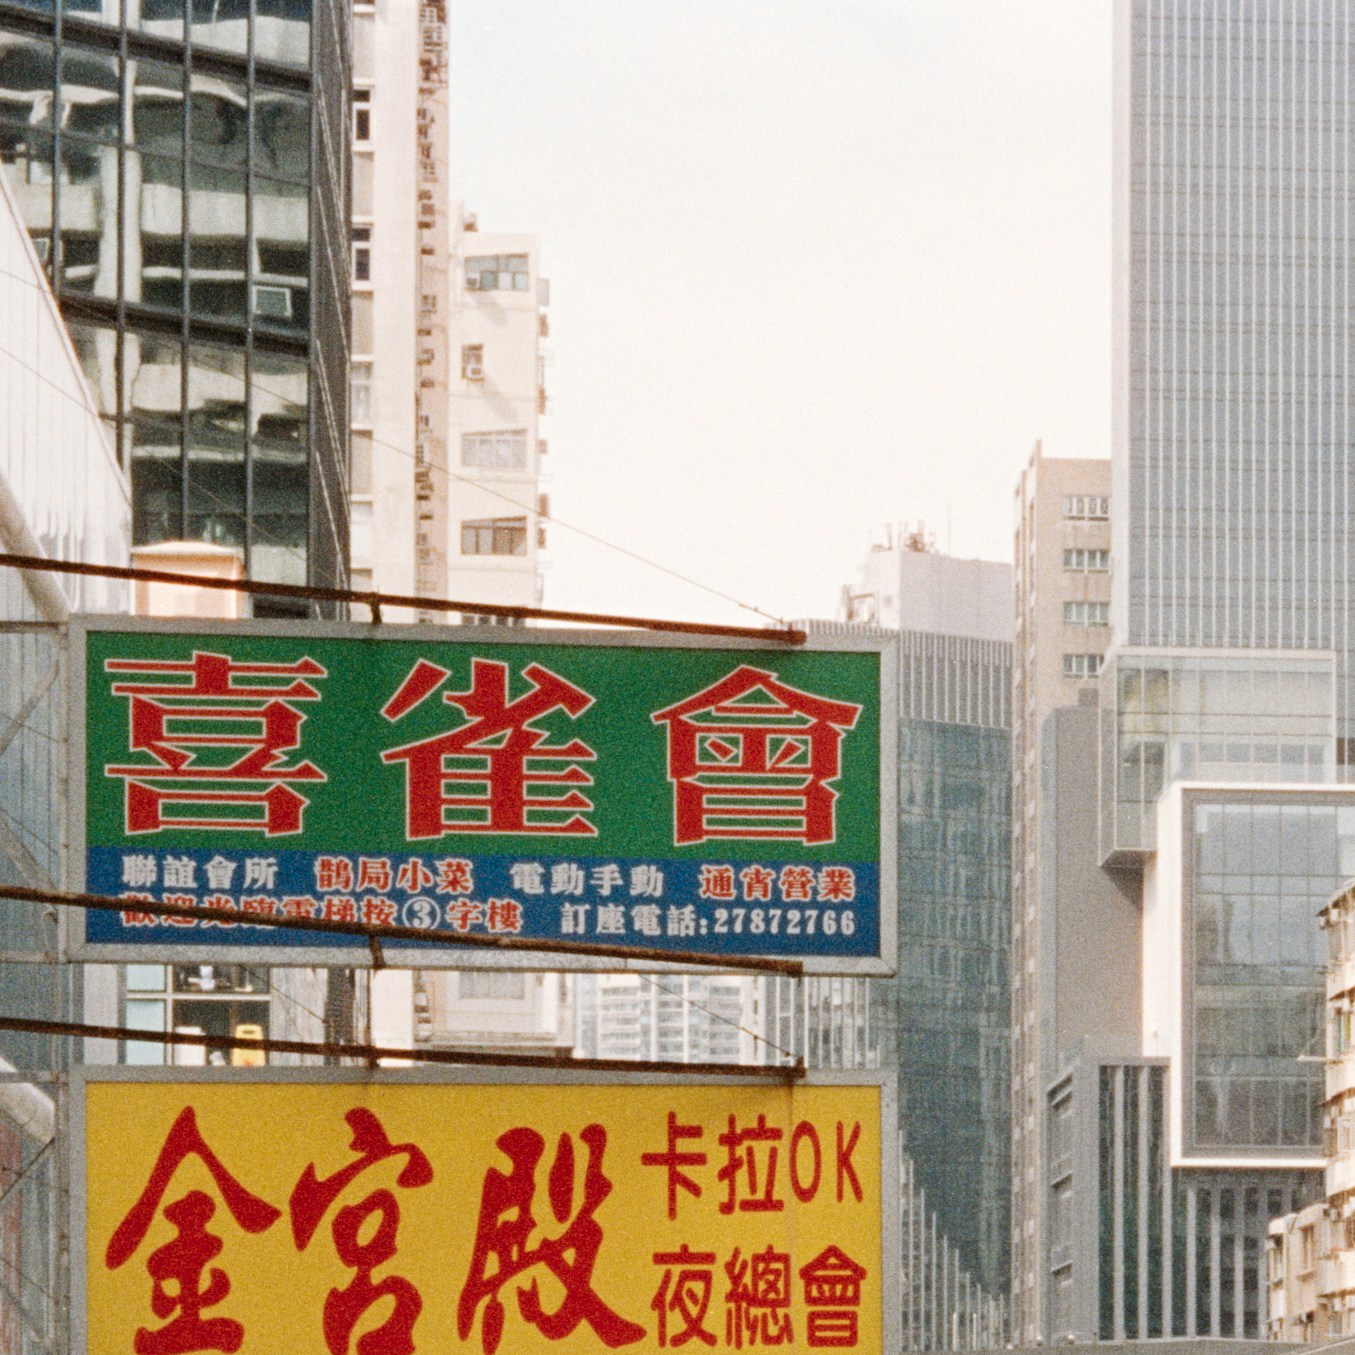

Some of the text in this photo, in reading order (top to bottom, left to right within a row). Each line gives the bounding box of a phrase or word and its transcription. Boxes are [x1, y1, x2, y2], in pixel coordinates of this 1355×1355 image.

[104, 650, 863, 846] 喜雀會
[510, 863, 664, 897] 電動手動
[699, 866, 856, 901] 通宵營業
[641, 1110, 865, 1220] 卡拉OK
[651, 1243, 868, 1349] 夜總會
